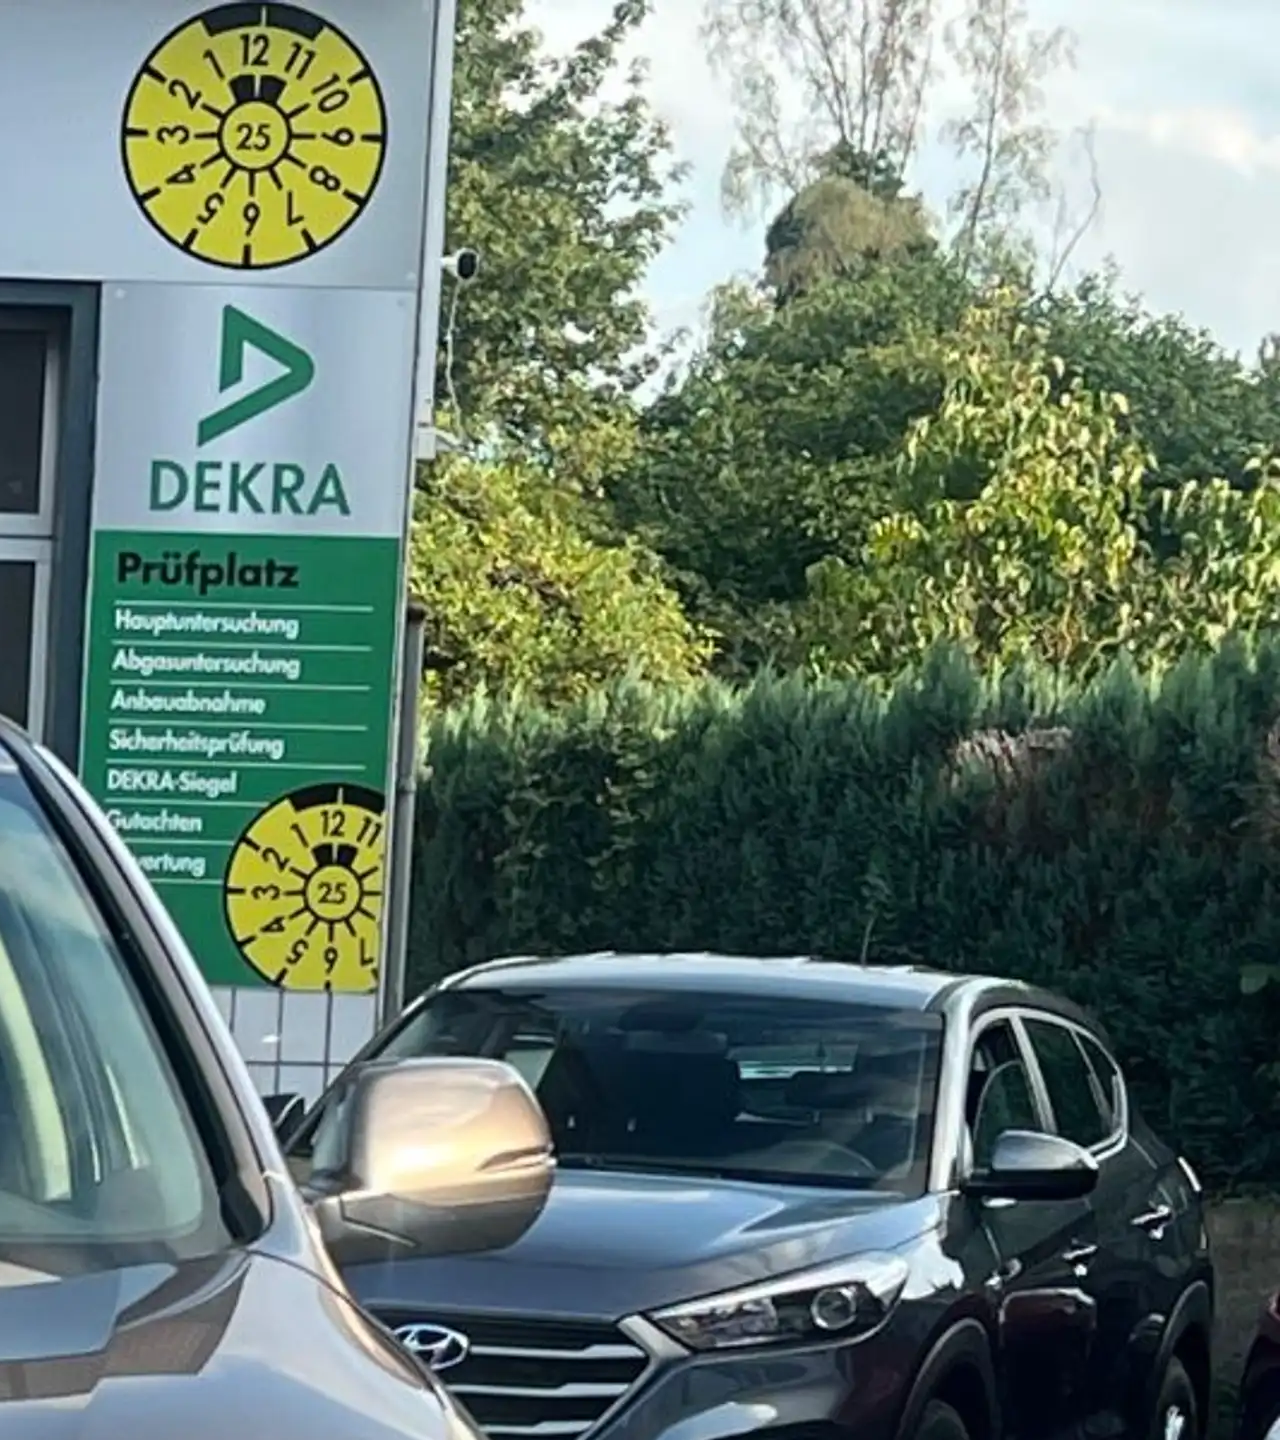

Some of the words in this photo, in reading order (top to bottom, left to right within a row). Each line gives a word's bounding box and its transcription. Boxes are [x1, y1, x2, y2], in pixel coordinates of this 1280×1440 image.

[240, 34, 270, 66] 12
[285, 42, 317, 80] 11
[203, 49, 225, 81] 1
[168, 79, 202, 110] 2
[312, 73, 350, 113] 10
[156, 125, 190, 145] 3
[236, 122, 271, 151] 25
[321, 127, 354, 147] 9
[165, 163, 196, 185] 4
[308, 165, 341, 192] 8
[196, 192, 225, 224] 5
[243, 202, 260, 236] 6
[287, 190, 304, 227] 7
[149, 459, 351, 516] DEKRA
[117, 550, 300, 595] Prüfplatz
[115, 608, 299, 640] Hauptuntersuchung
[112, 648, 301, 680] Abgasuntersuchung
[111, 687, 266, 714] Anbauabnahme
[108, 727, 284, 760] Sicherheitsprüfung
[107, 769, 238, 798] DEKRA-Siegel
[106, 808, 203, 832] Gutachten
[320, 810, 345, 837] 12
[357, 816, 382, 847] 11
[290, 823, 309, 847] 1
[140, 853, 206, 877] ertung
[262, 848, 289, 872] 2
[251, 884, 280, 900] 3
[317, 882, 347, 904] 25
[260, 916, 284, 933] 4
[286, 939, 308, 964] 5
[360, 937, 374, 966] 7
